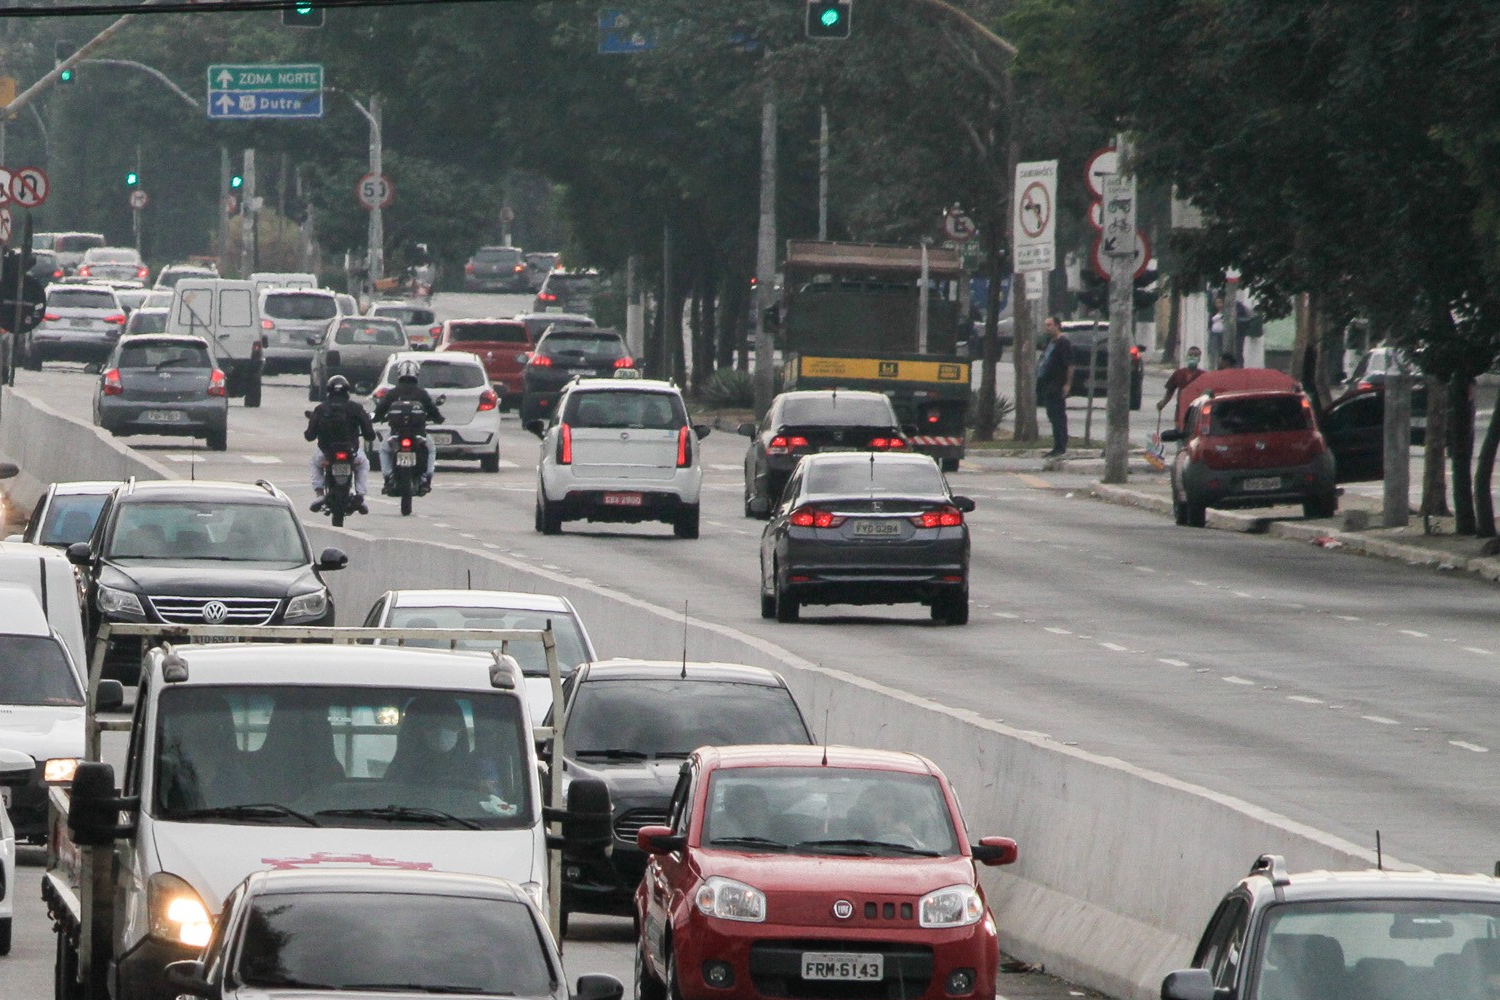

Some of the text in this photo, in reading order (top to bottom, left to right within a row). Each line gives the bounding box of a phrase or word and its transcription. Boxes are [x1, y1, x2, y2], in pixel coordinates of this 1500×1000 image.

[240, 73, 317, 84] ZONA NORTE
[260, 98, 301, 109] Dutra
[364, 181, 386, 197] 50
